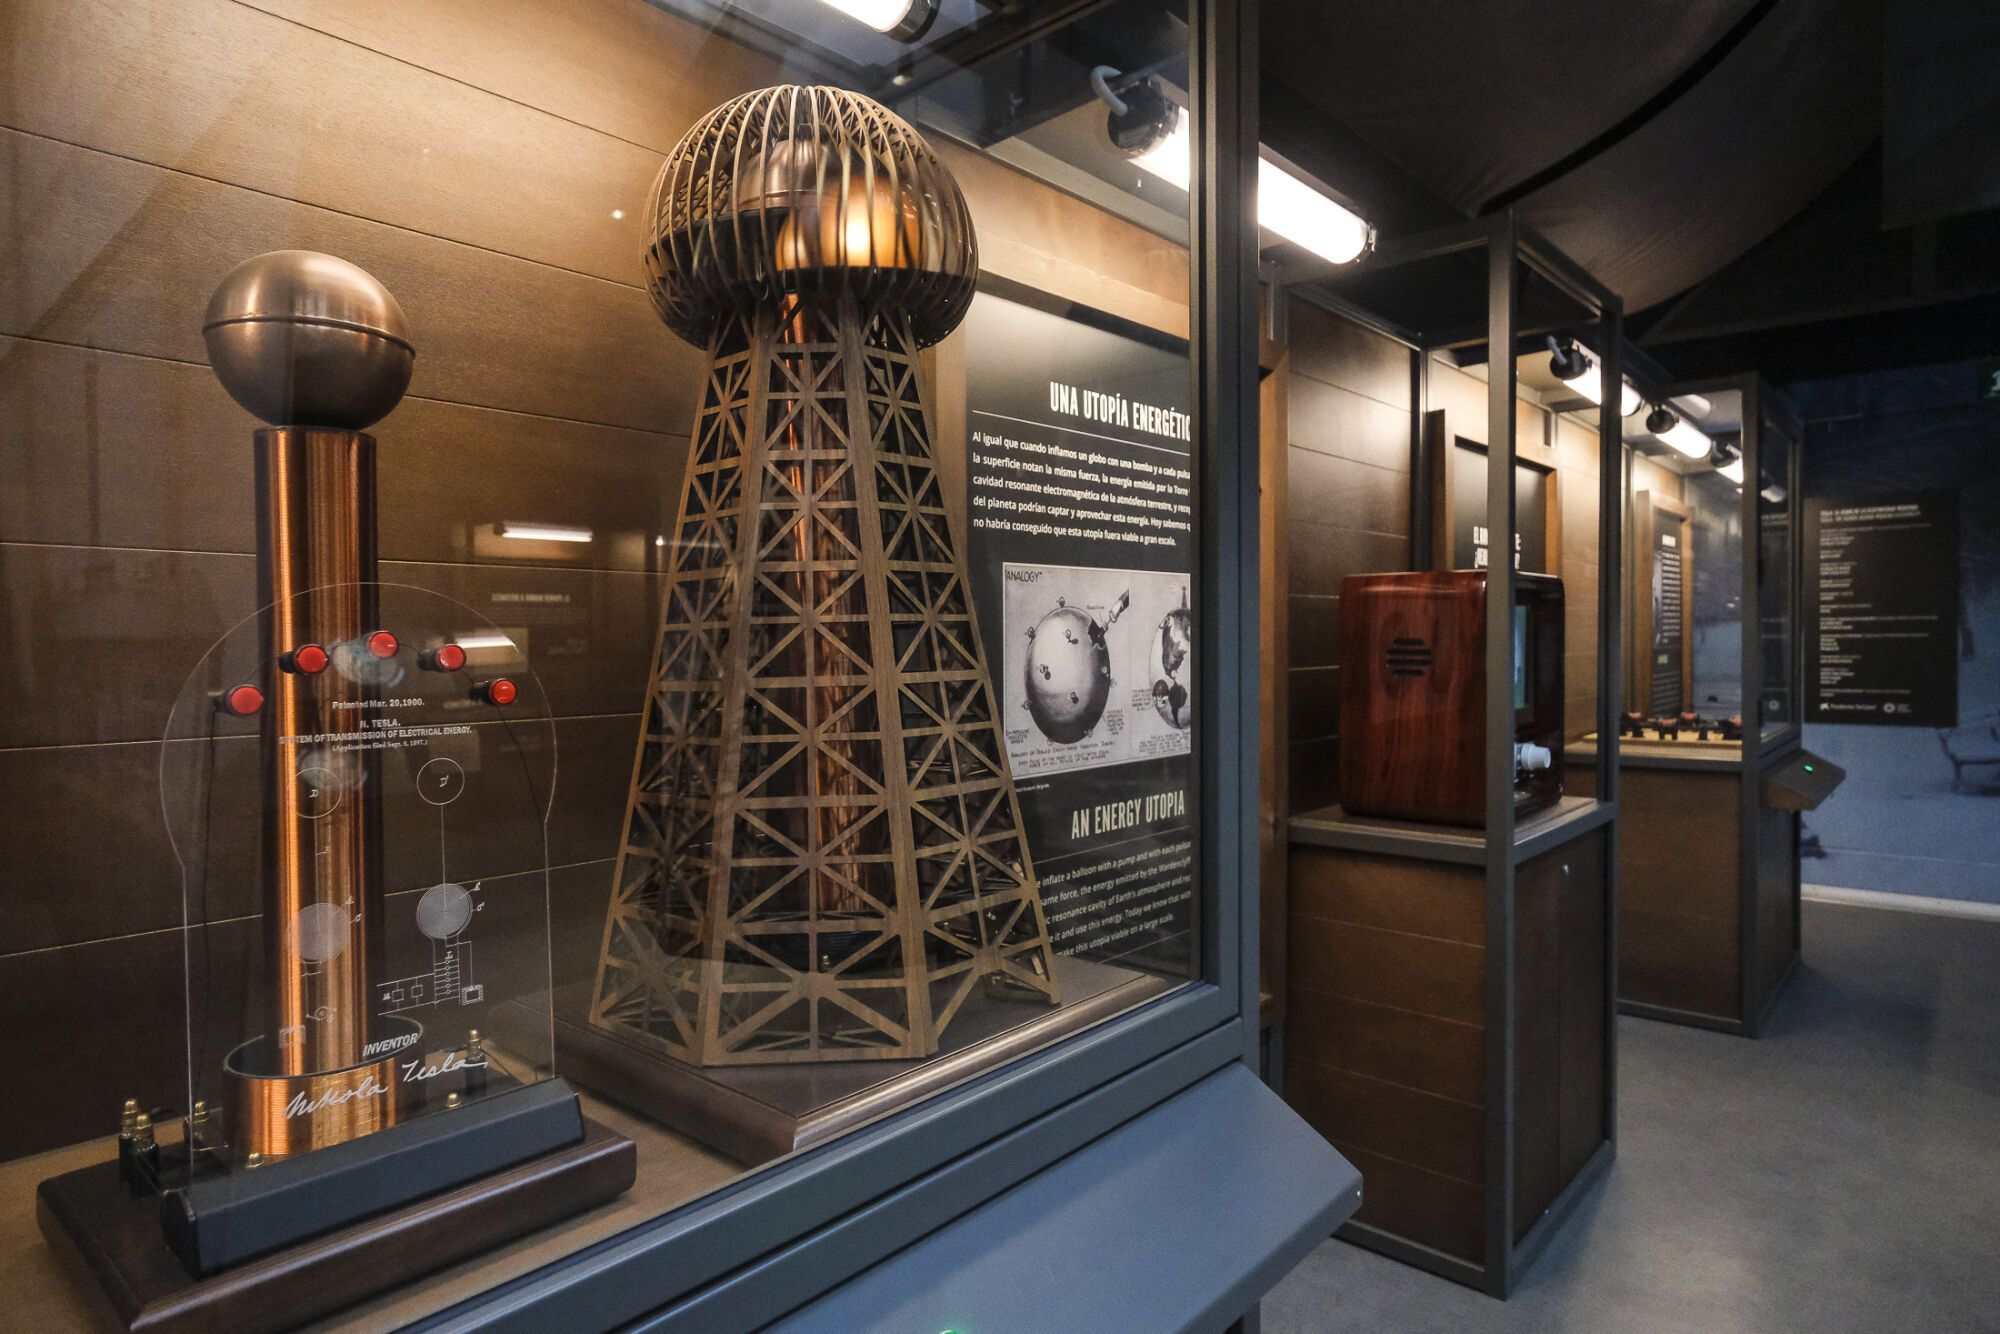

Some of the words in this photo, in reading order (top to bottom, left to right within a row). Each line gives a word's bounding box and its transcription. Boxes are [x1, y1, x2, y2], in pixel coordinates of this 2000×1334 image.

[1050, 381, 1079, 417] UNA
[1083, 389, 1129, 428] UTOPÍA
[973, 431, 981, 443] Al
[983, 433, 1002, 447] igual
[1004, 438, 1019, 450] que
[1020, 442, 1047, 454] cuando
[1048, 444, 1078, 460] inflamos
[1079, 452, 1088, 461] un
[1088, 452, 1107, 465] globo
[1107, 457, 1119, 467] con
[1120, 460, 1132, 469] una
[1132, 459, 1153, 473] bomba
[1163, 466, 1177, 477] cada
[973, 452, 981, 464] la
[983, 456, 1021, 469] superficie
[1022, 461, 1044, 474] notan
[1045, 463, 1053, 475] la
[1054, 466, 1077, 479] misma
[1078, 469, 1101, 483] fuerza,
[1102, 473, 1109, 483] la
[1109, 476, 1133, 489] energía
[1156, 483, 1167, 494] por
[973, 475, 1004, 489] cavidad
[1005, 479, 1042, 493] resonante
[1043, 484, 1100, 501] electromagnética
[1100, 491, 1109, 503] de
[1109, 492, 1116, 503] la
[973, 495, 986, 506] del
[988, 497, 1017, 510] planeta
[1018, 501, 1047, 514] podrían
[1047, 505, 1070, 517] captar
[1070, 509, 1076, 520] y
[1076, 509, 1112, 522] aprovechar
[1112, 513, 1126, 523] esta
[973, 518, 984, 528] no
[986, 517, 1011, 530] habría
[1012, 521, 1052, 535] conseguido
[1054, 526, 1067, 537] que
[1068, 527, 1082, 537] esta
[1083, 528, 1104, 541] utopía
[1104, 529, 1121, 541] fuera
[332, 701, 368, 709] Patented
[369, 699, 388, 708] Mar.
[314, 734, 326, 743] OF
[327, 730, 386, 742] TRANSMISSION
[387, 729, 399, 738] OF
[399, 726, 443, 738] ELECTRICAL
[443, 725, 473, 735] ENERGY.
[372, 718, 401, 728] TESLA.
[1071, 808, 1090, 839] AN
[1094, 798, 1142, 834] ENERGY
[1145, 789, 1185, 823] UTOPIA
[1042, 872, 1066, 887] inflate
[1066, 873, 1071, 881] a
[1072, 865, 1097, 879] balloon
[1097, 860, 1112, 873] with
[1112, 860, 1117, 869] a
[1117, 855, 1136, 868] pump
[1136, 850, 1148, 862] and
[1080, 884, 1092, 896] the
[1093, 879, 1115, 891] energy
[1115, 870, 1139, 886] emitted
[1139, 868, 1148, 880] by
[1052, 904, 1088, 923] resonance
[1088, 899, 1107, 912] cavity
[1107, 895, 1115, 906] of
[1061, 927, 1075, 939] and
[1075, 923, 1088, 935] use
[1088, 919, 1101, 931] this
[1125, 905, 1143, 918] Today
[1075, 942, 1089, 953] this
[1089, 934, 1110, 949] utopia
[363, 1033, 419, 1057] INVENTOR
[284, 1075, 389, 1120] Nikola
[402, 1052, 489, 1083] Tesla
